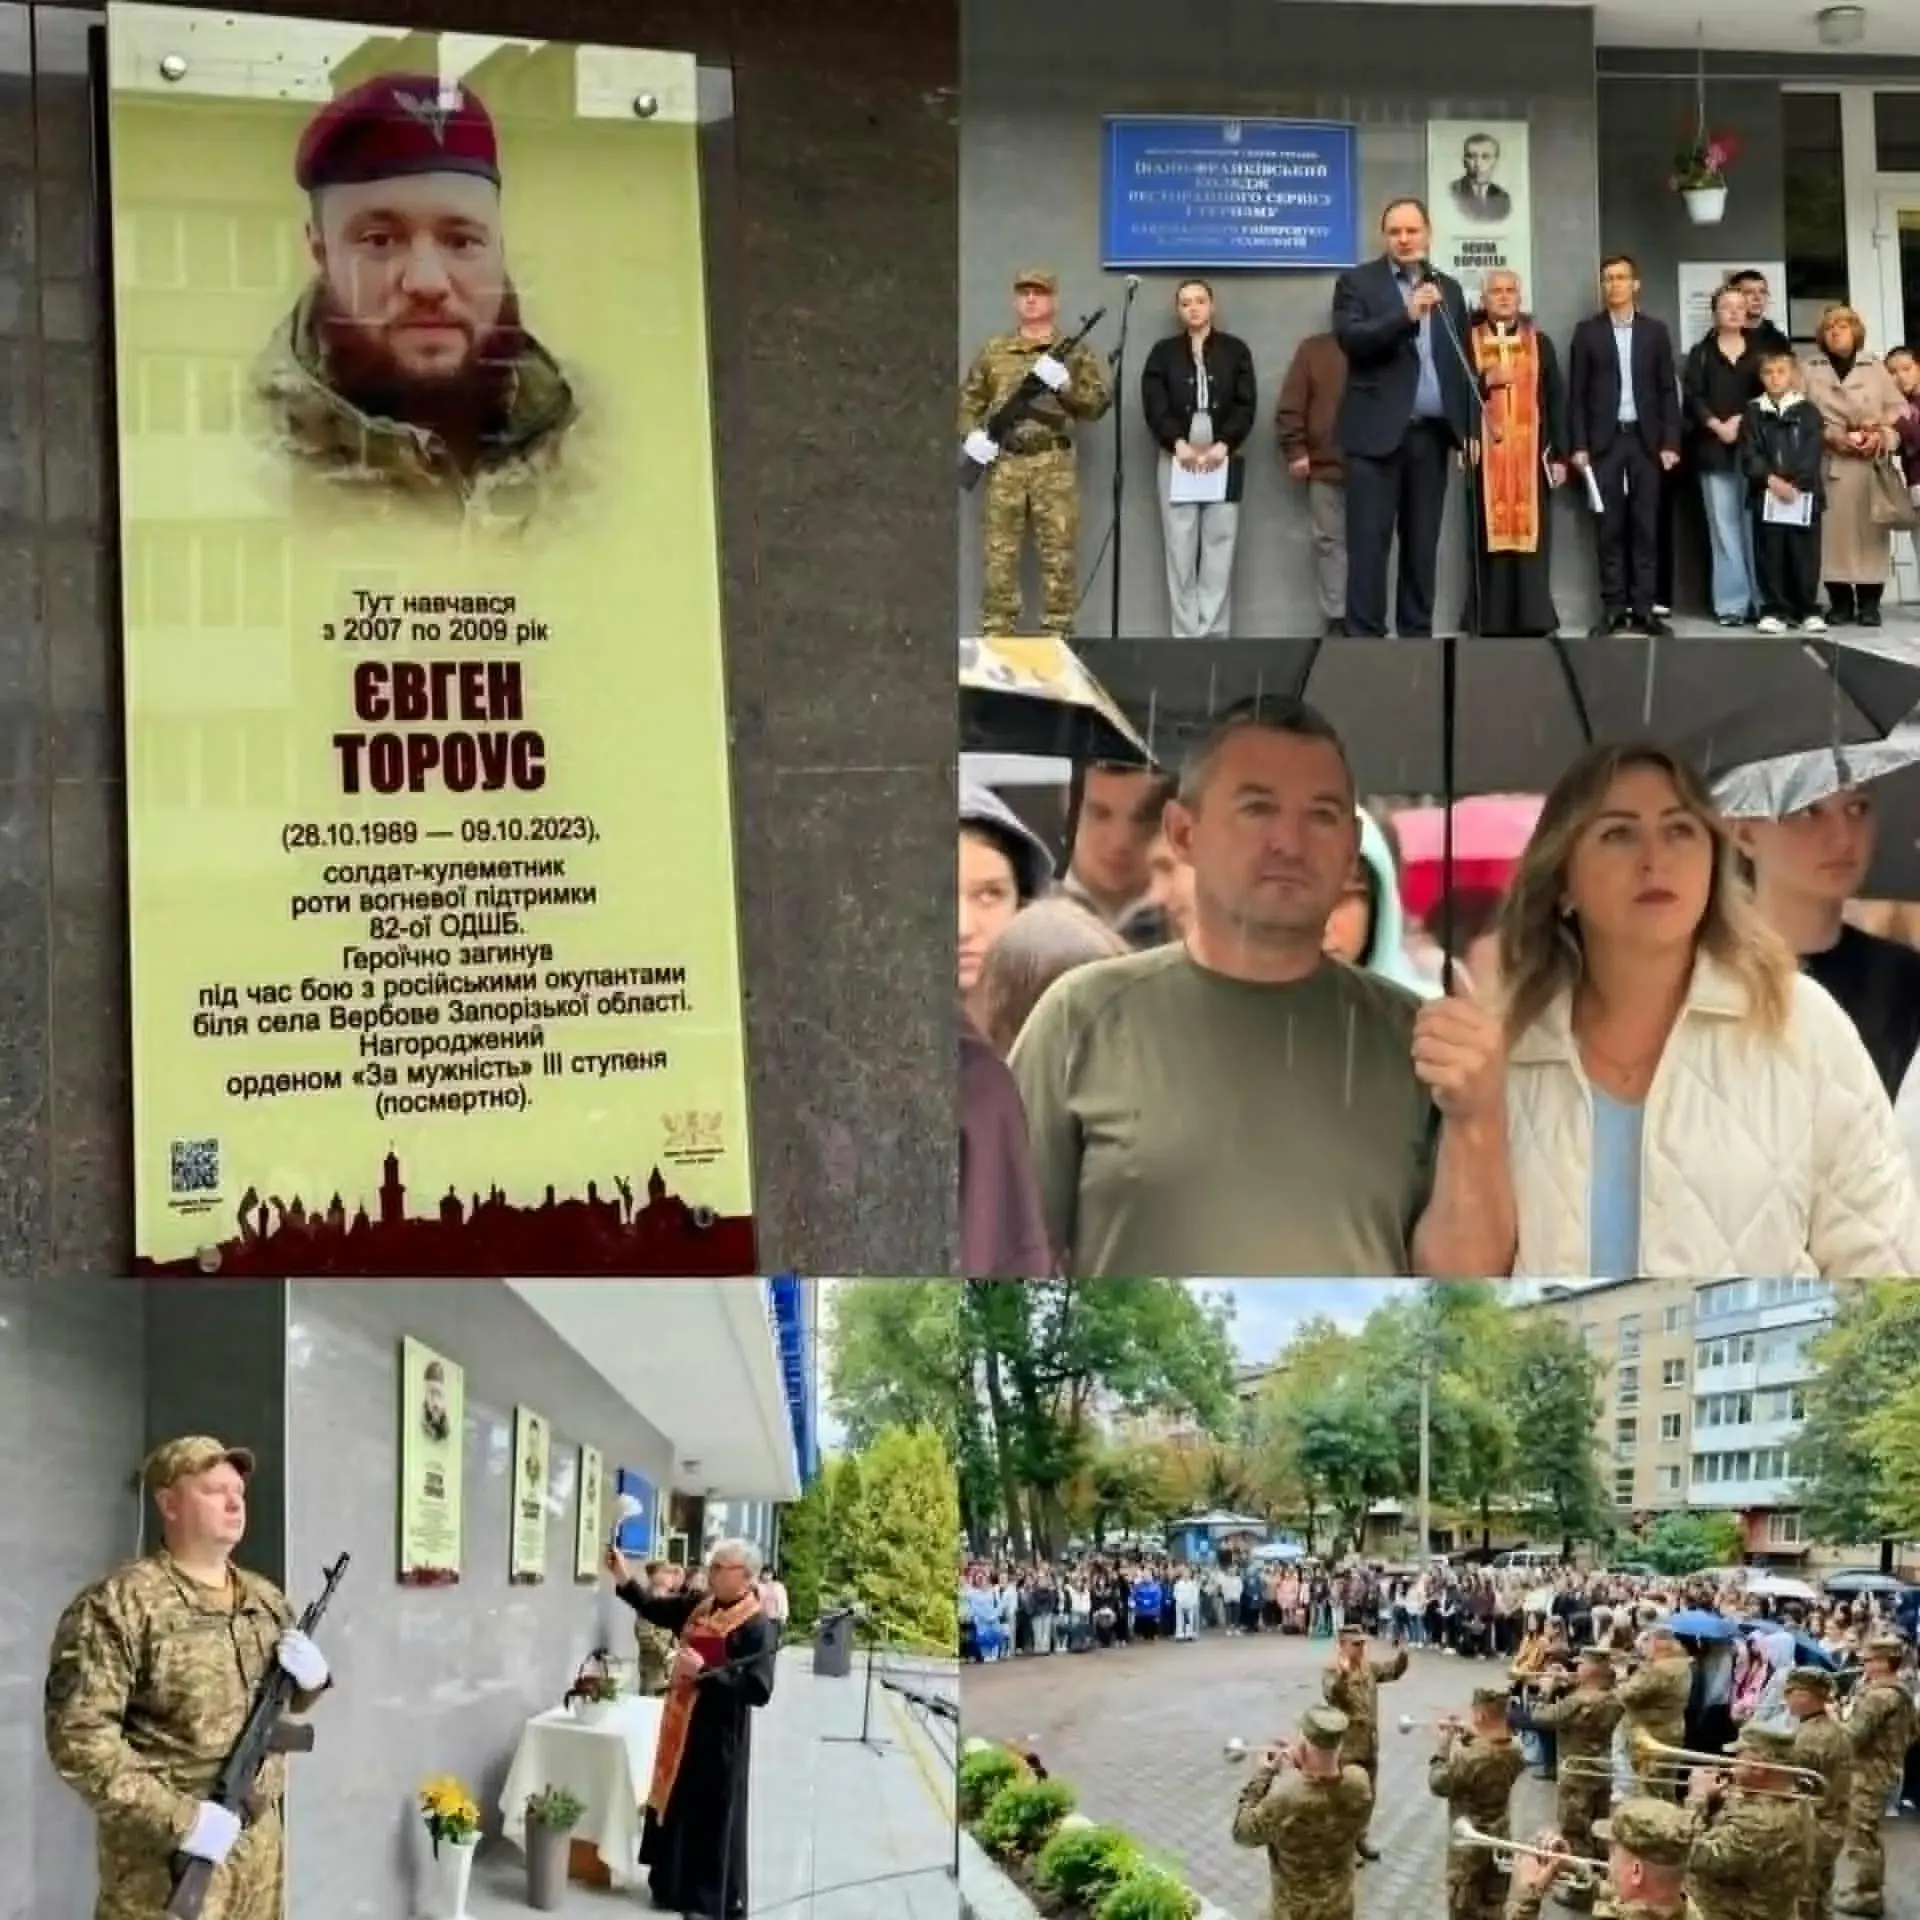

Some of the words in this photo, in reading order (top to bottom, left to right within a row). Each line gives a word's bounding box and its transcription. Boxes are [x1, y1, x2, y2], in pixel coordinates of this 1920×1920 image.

[353, 590, 394, 617] Тут
[403, 595, 516, 616] навчався
[322, 623, 336, 641] з
[343, 617, 402, 641] 2007
[411, 622, 441, 641] по
[449, 617, 508, 642] 2009
[516, 617, 549, 646] рік
[353, 660, 524, 723] ЄВГЕН
[332, 730, 547, 795] ТОРОУС
[281, 820, 418, 852] (28.10.1989
[322, 858, 565, 888] солдат-кулеметник
[291, 895, 351, 920] роти
[359, 887, 467, 912] вогневої
[475, 883, 597, 911] підтримки
[369, 914, 432, 940] 82-ої
[440, 912, 526, 941] ОДШБ.
[343, 943, 451, 975] Героїчно
[458, 943, 553, 969] загинув
[198, 983, 239, 1010] під
[247, 983, 292, 1005] час
[301, 977, 353, 1003] бою
[361, 980, 375, 999] з
[383, 971, 538, 1006] російськими
[545, 966, 686, 994] окупантами
[193, 1011, 248, 1037] біля
[257, 1011, 321, 1035] села
[329, 1001, 440, 1033] Вербове
[447, 993, 590, 1026] Запорізької
[596, 988, 693, 1017] області.
[358, 1024, 545, 1060] Нагороджений
[226, 1069, 343, 1101] орденом
[351, 1062, 398, 1088] «За
[407, 1055, 533, 1088] мужність»
[571, 1050, 668, 1078] ступеня
[375, 1083, 533, 1121] (посмертно).
